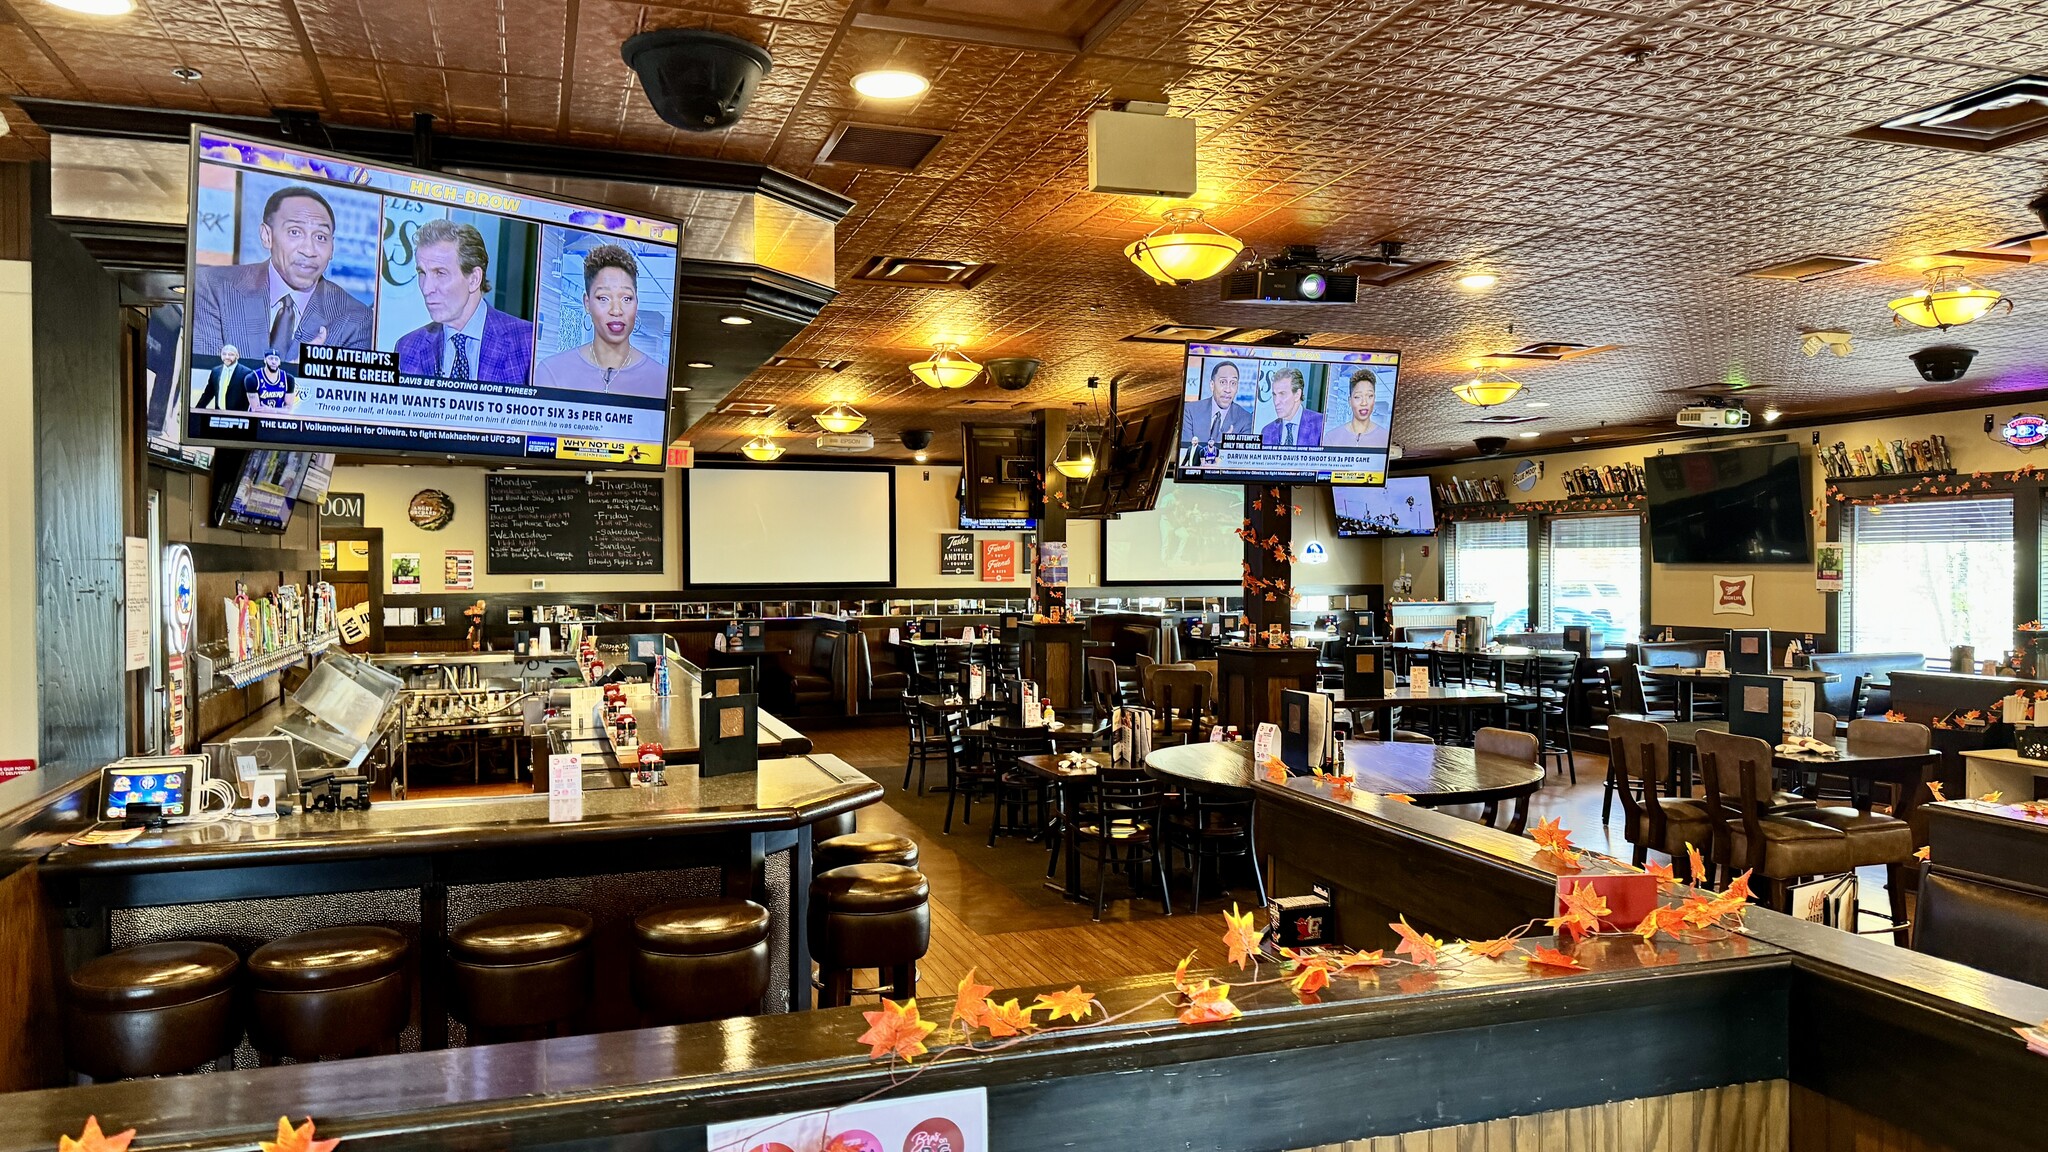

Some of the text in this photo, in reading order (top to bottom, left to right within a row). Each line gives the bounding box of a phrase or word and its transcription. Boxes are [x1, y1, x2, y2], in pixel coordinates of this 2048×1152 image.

[410, 179, 521, 213] HIGH-BROW
[306, 345, 394, 367] 1000 ATTEMPTS.
[304, 363, 395, 384] ONLY THE GREEK
[399, 376, 538, 396] DAVIS BE SHOOTING MORE THREES?
[316, 387, 367, 403] DARVIN
[370, 392, 399, 405] HAM
[402, 394, 446, 409] WANTS
[449, 398, 484, 412] DAVIS
[488, 402, 503, 413] TO
[506, 403, 544, 416] SHOOT
[547, 407, 565, 419] SIX
[567, 409, 580, 420] 3s
[582, 410, 603, 422] PER
[605, 412, 634, 425] GAME
[209, 416, 249, 429] ESPN
[260, 420, 298, 430] THE LEAD
[305, 422, 353, 433] Volkanovski
[354, 425, 361, 433] in
[363, 426, 375, 435] for
[376, 427, 408, 437] Oliveira,
[419, 430, 437, 440] fight
[437, 431, 480, 441] Makhachev
[480, 434, 489, 442] at
[490, 435, 505, 444] UFC
[506, 436, 521, 444] 294
[563, 439, 587, 447] WHY
[668, 449, 688, 466] EXIT
[1249, 453, 1262, 461] HAM
[320, 497, 361, 517] OOM
[944, 553, 973, 561] ANOTHER
